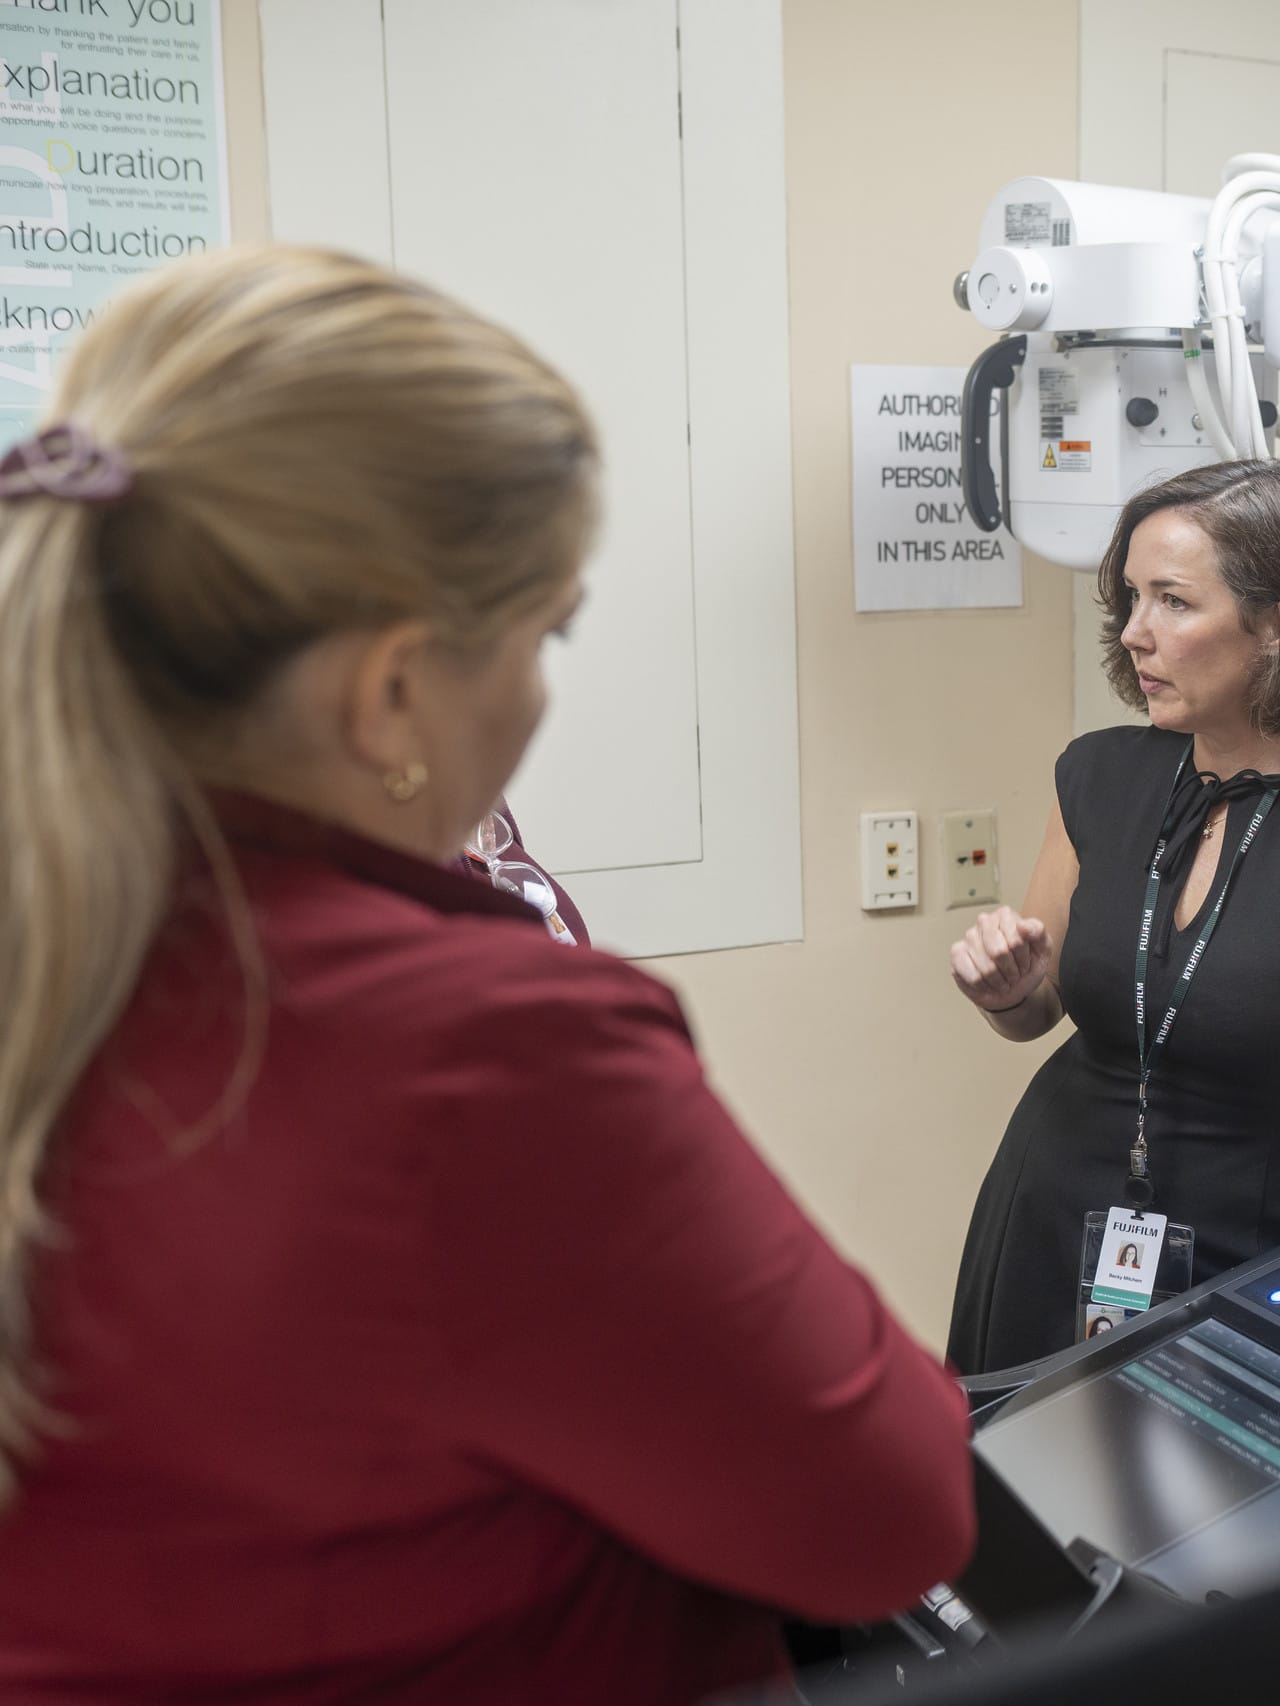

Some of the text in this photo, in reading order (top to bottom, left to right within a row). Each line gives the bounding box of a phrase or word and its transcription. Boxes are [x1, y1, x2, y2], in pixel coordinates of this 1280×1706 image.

[47, 139, 204, 183] Duration
[877, 395, 1001, 417] AUTHORID
[915, 503, 967, 524] ONLY
[877, 540, 1005, 563] IN THIS AREA
[1239, 812, 1264, 854] FUJIFILM
[1139, 908, 1153, 952] FUJIFILM
[1182, 938, 1206, 982] FUJIFILM
[1136, 981, 1145, 1025] FUJIFILM
[1155, 1005, 1177, 1046] FUJIFILM
[1112, 1221, 1159, 1238] FUJIFILM
